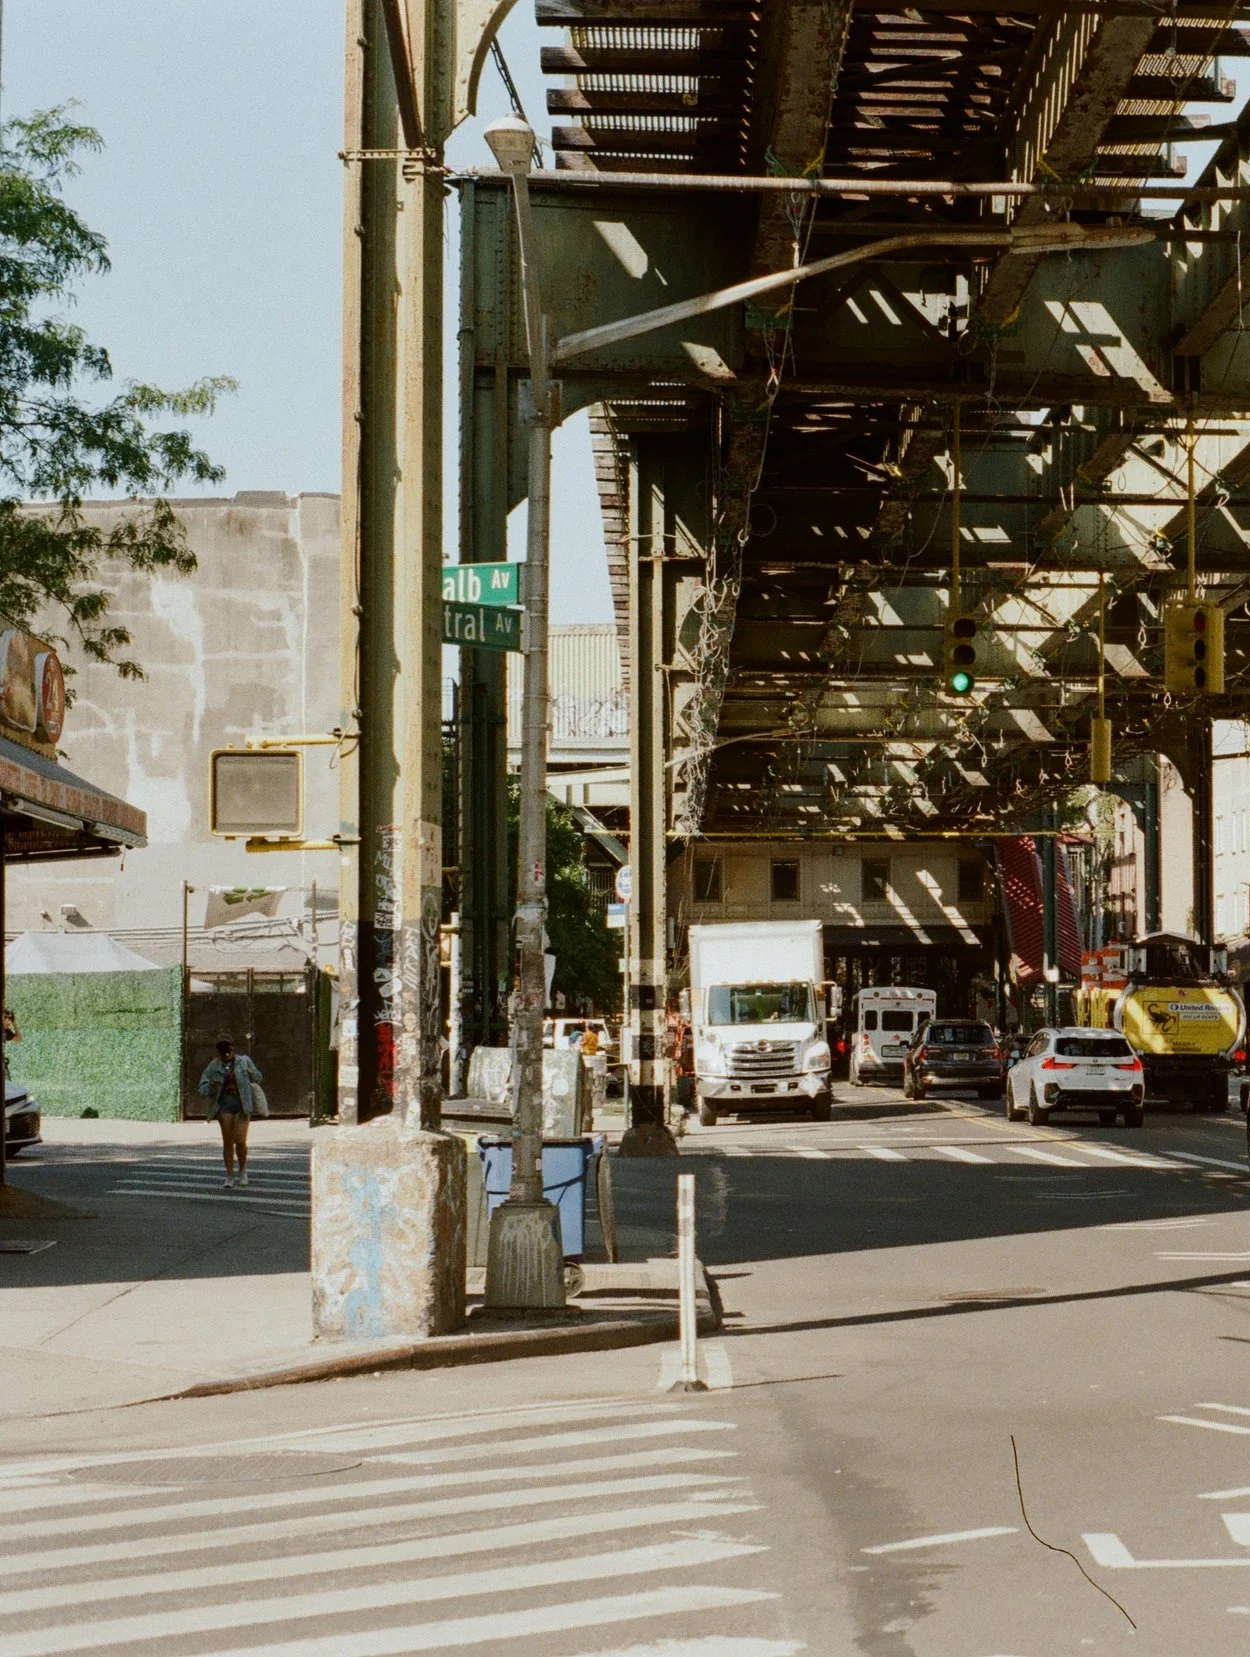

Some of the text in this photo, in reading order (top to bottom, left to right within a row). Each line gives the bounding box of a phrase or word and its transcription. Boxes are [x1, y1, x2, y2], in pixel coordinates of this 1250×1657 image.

[442, 568, 510, 603] alb Av
[444, 605, 512, 642] tral Av
